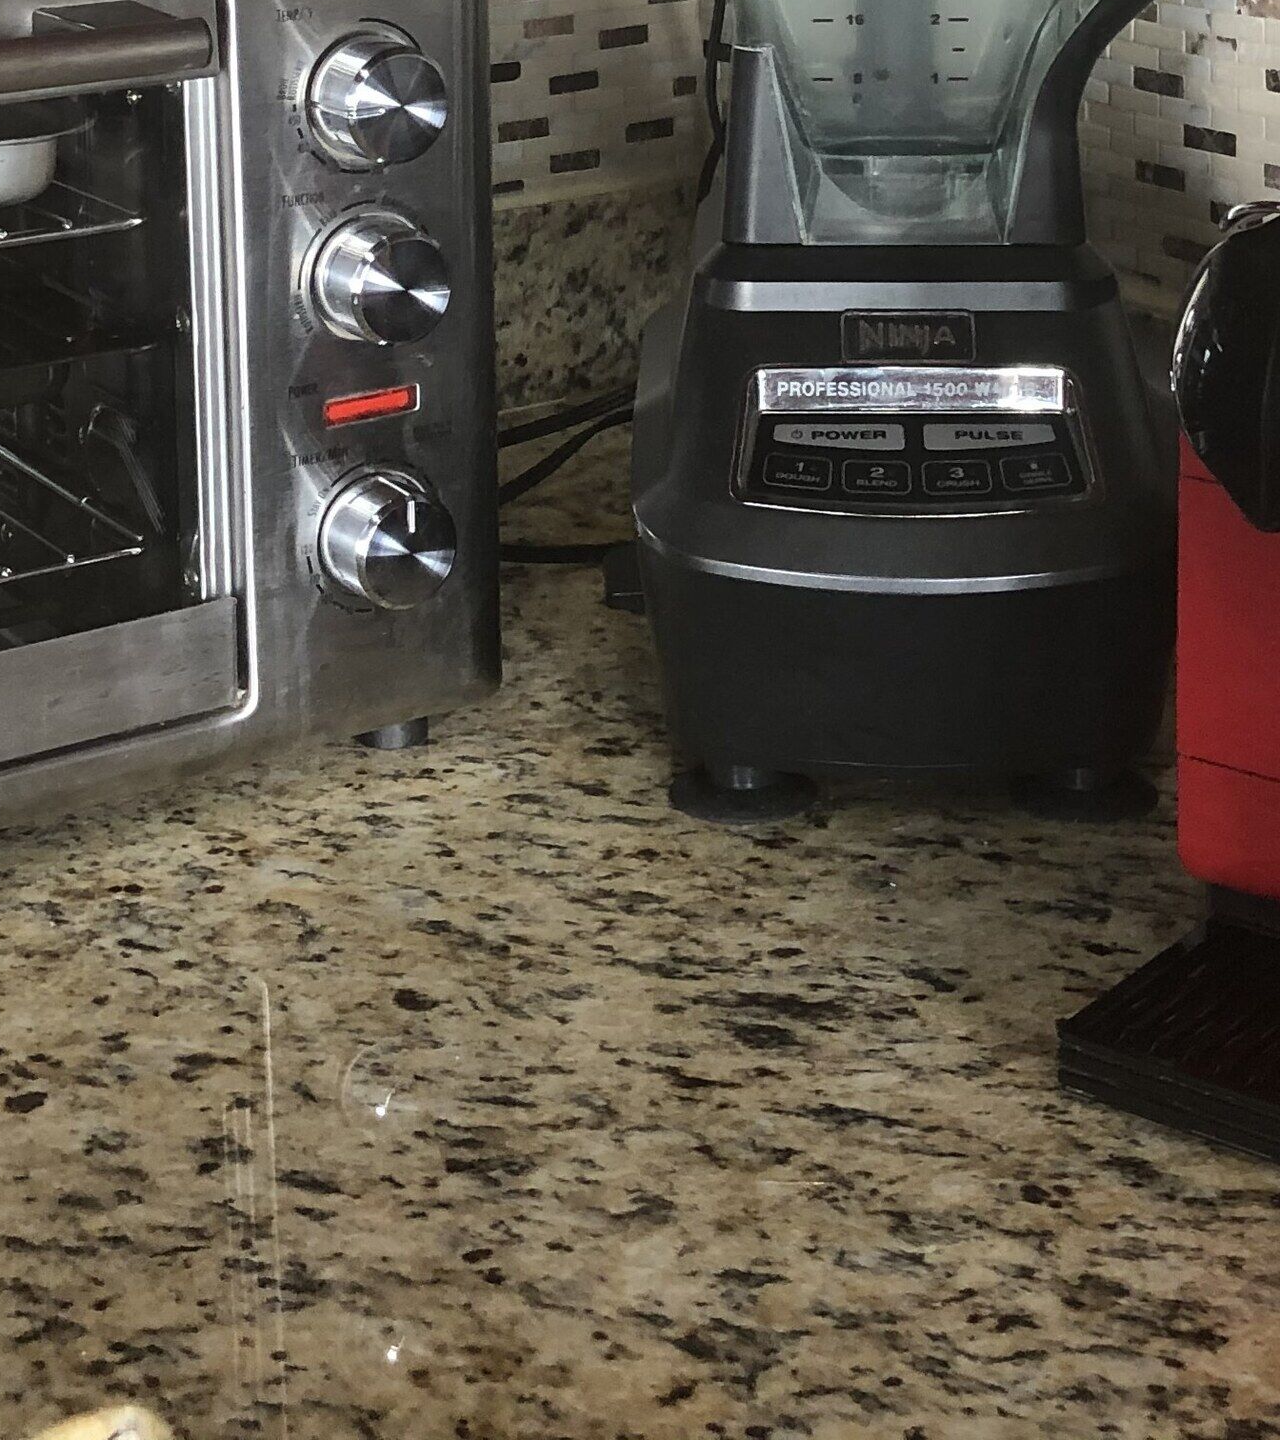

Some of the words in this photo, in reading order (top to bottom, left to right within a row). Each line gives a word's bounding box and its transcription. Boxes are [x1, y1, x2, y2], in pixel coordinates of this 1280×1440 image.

[845, 14, 864, 26] 16
[930, 13, 940, 25] 2
[930, 73, 939, 84] 1
[777, 380, 917, 398] PROFESSIONAL
[811, 429, 887, 440] POWER
[954, 429, 1024, 441] PULSE
[796, 461, 806, 472] 1
[869, 467, 885, 478] 2
[948, 467, 965, 479] 3
[856, 478, 898, 488] BLEND
